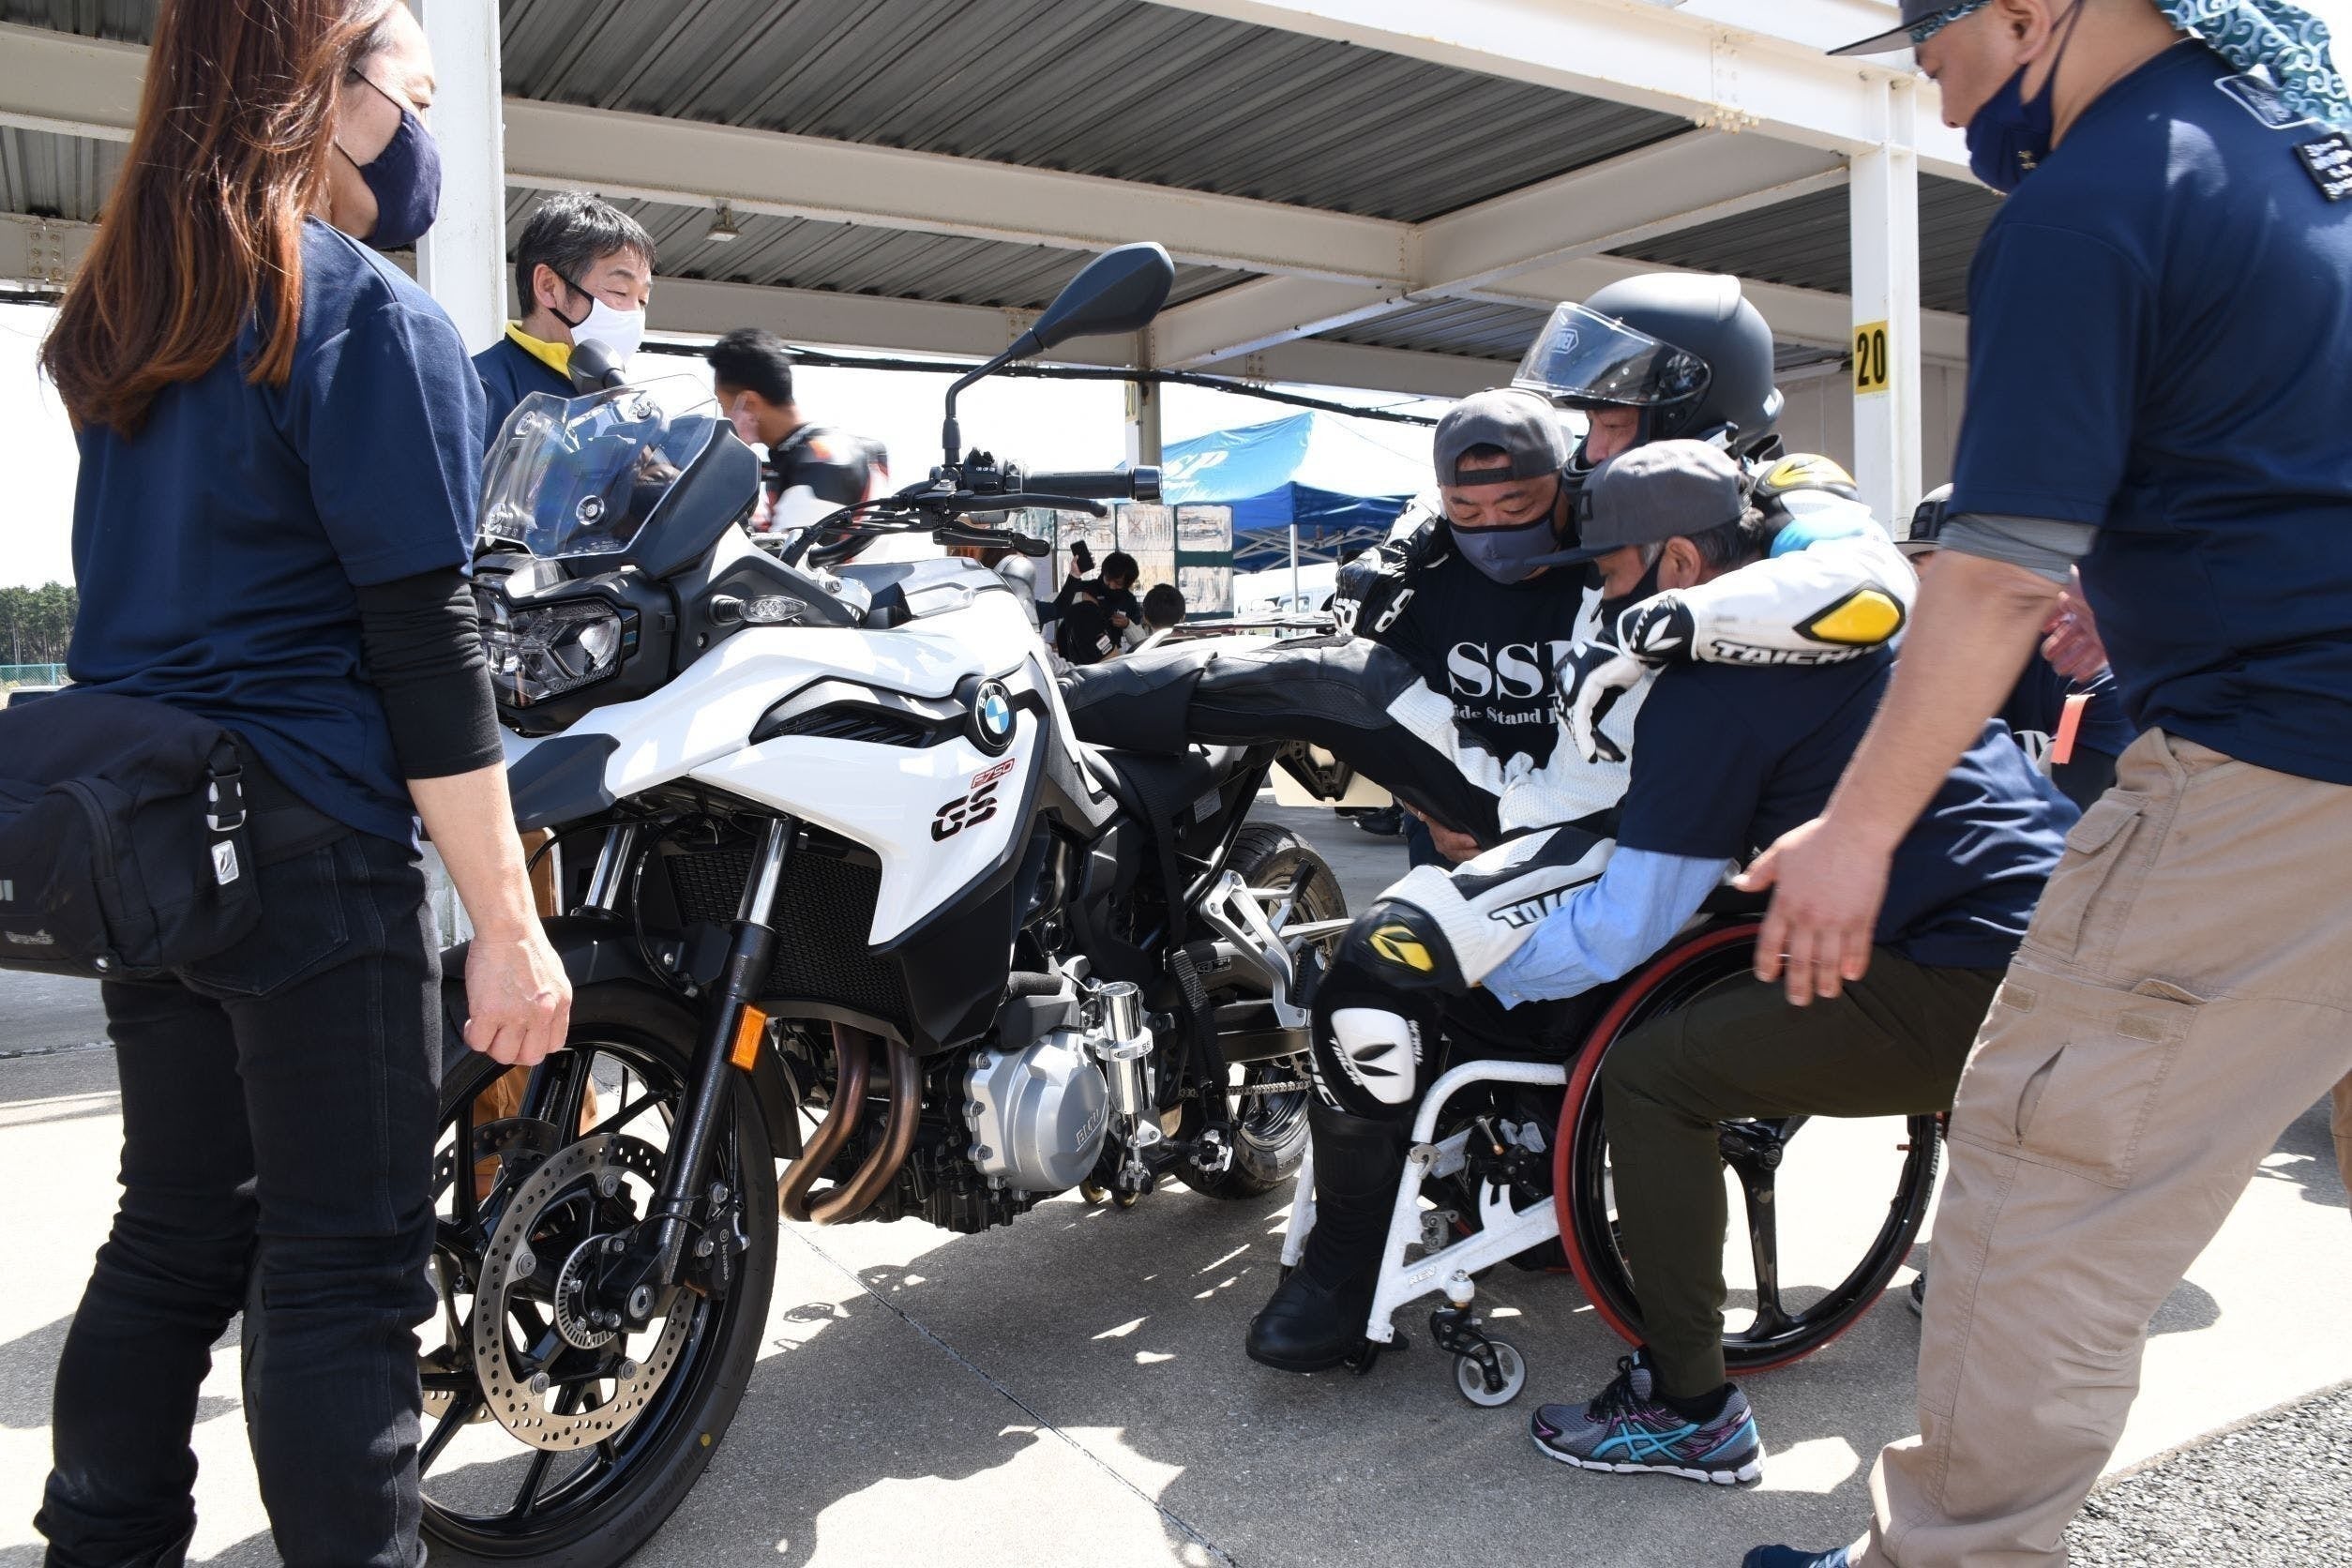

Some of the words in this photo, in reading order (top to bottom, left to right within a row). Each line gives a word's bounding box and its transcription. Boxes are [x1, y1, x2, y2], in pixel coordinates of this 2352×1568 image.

[1858, 329, 1886, 386] 20
[1125, 383, 1137, 418] 20
[1453, 703, 1482, 719] ide
[1486, 706, 1543, 725] Stand
[972, 758, 1015, 788] F750
[931, 781, 999, 842] GS
[721, 1244, 730, 1281] brembo
